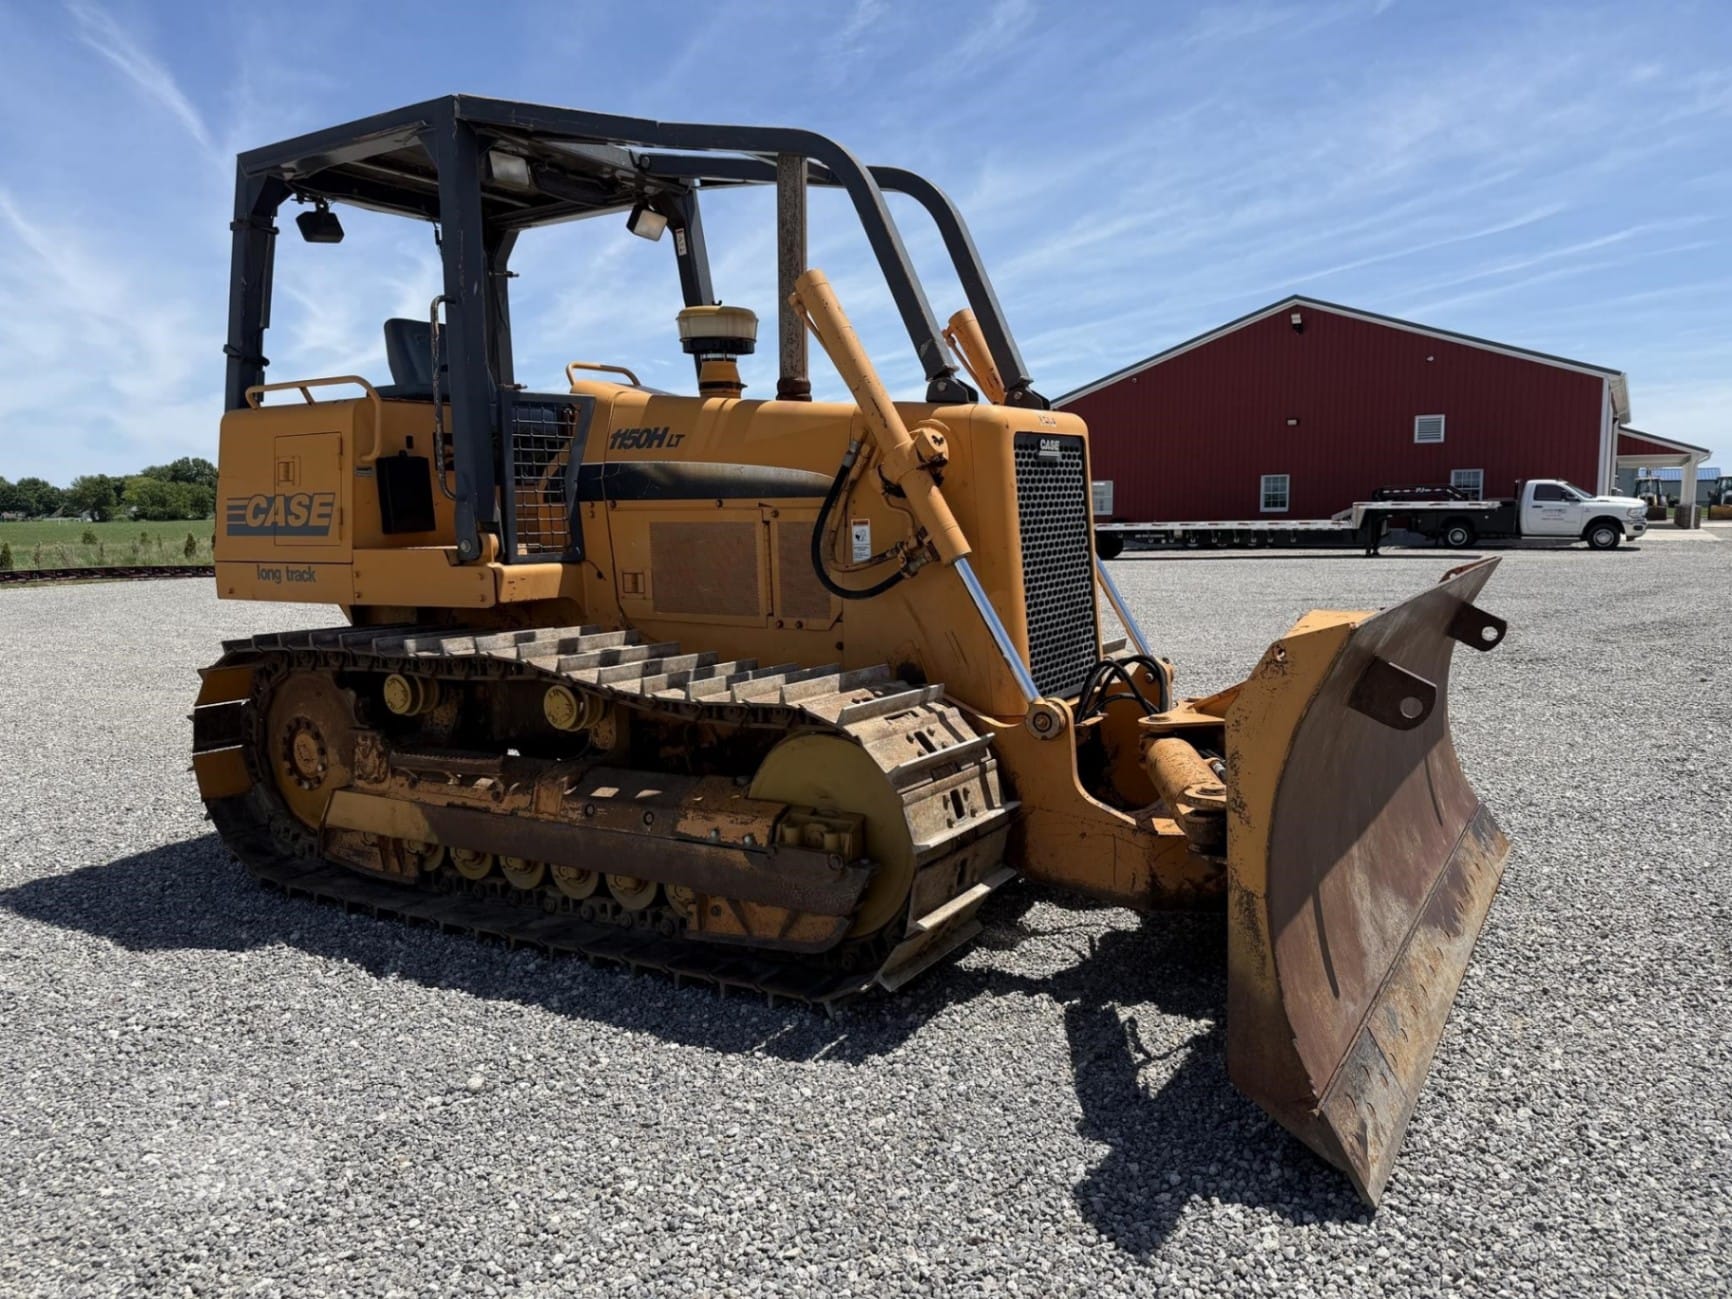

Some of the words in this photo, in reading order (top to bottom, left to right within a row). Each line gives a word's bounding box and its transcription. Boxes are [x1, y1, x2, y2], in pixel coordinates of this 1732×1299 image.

[609, 427, 670, 450] 1150H
[666, 433, 686, 448] LT
[1040, 439, 1060, 450] CASE
[246, 493, 335, 527] CASE
[256, 564, 281, 584] long
[286, 565, 316, 582] track
